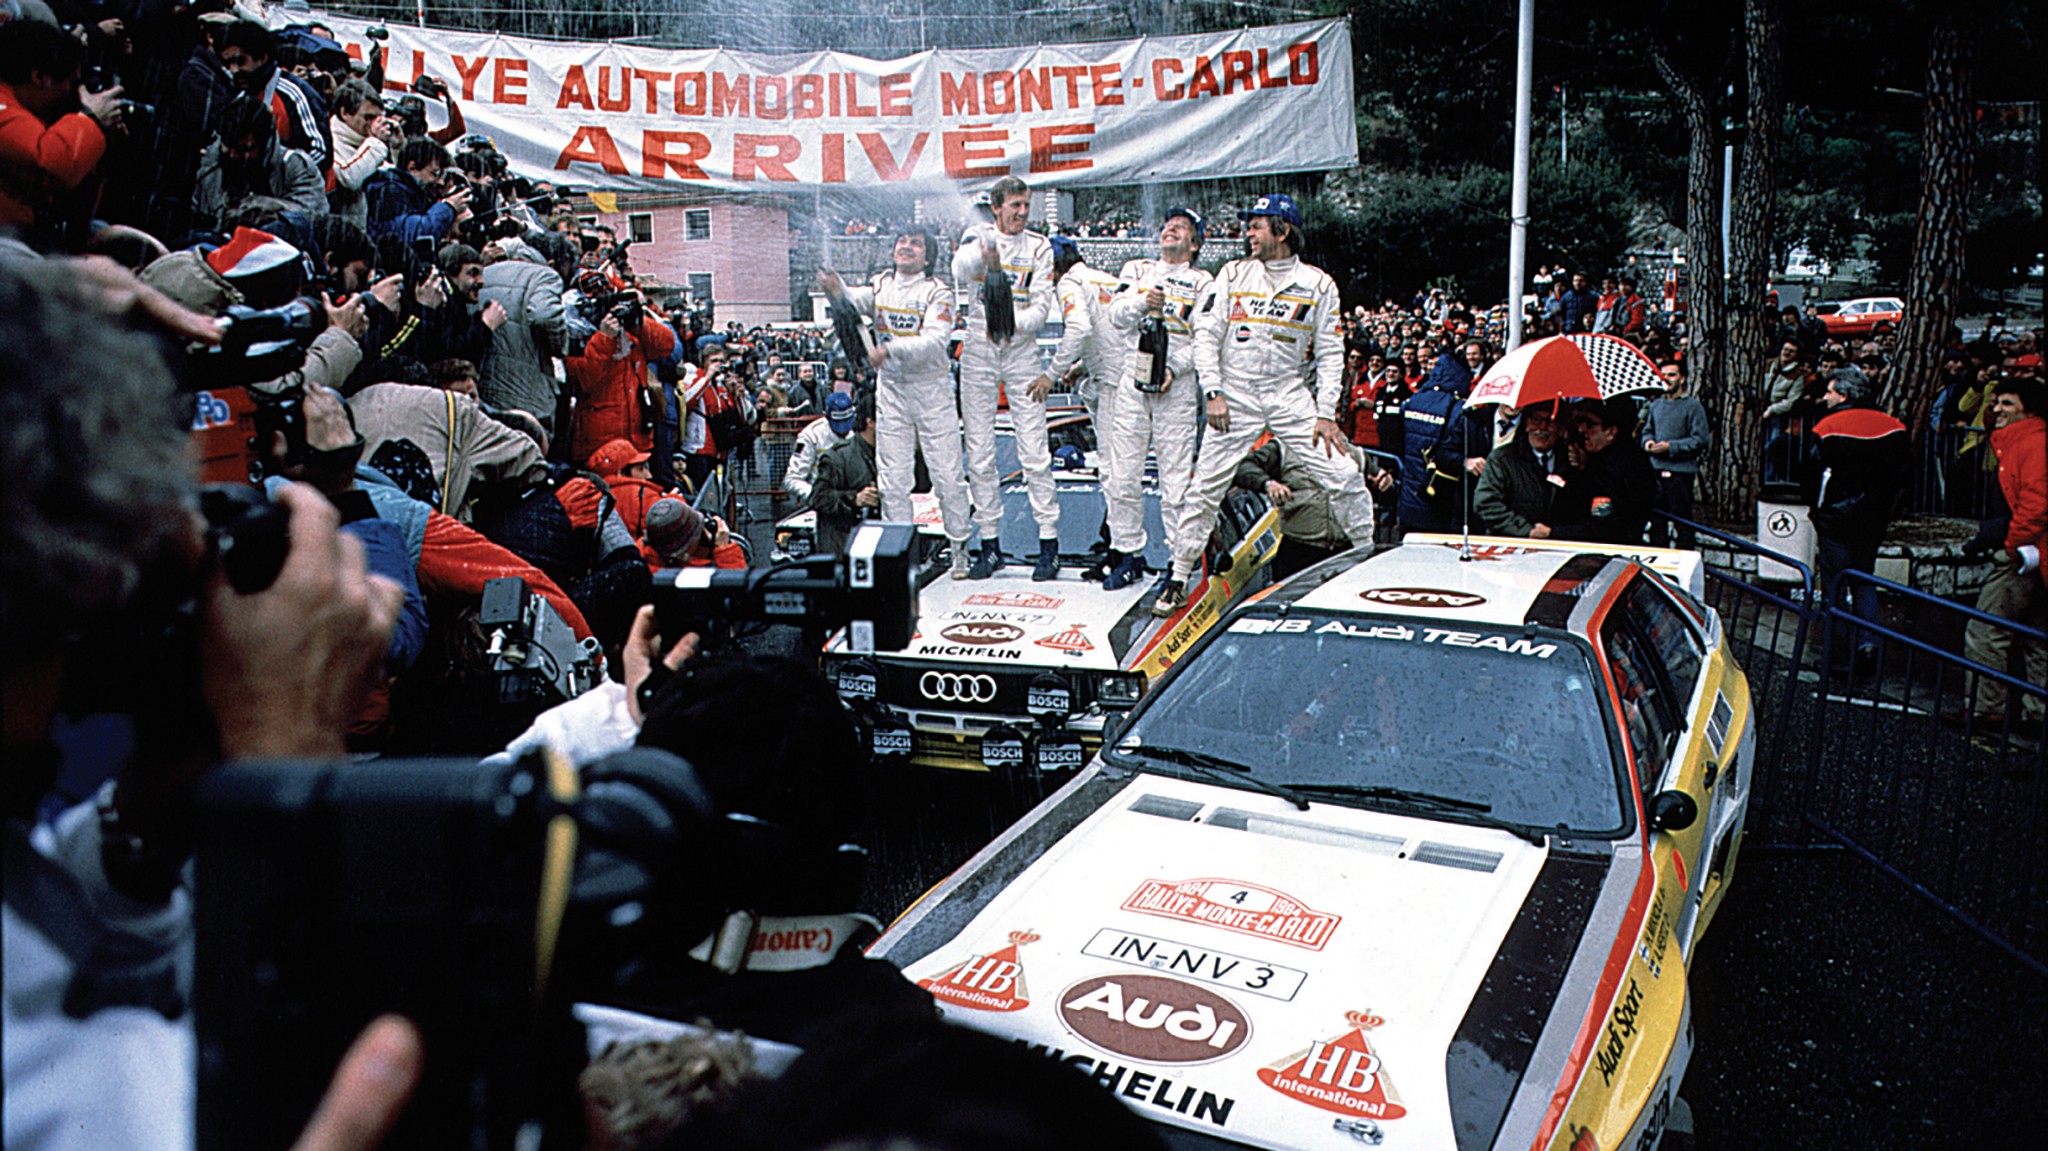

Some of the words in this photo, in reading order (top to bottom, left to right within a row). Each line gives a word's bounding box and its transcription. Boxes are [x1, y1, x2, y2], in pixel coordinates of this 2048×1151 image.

[556, 64, 913, 120] AUTOMOBILE
[940, 41, 1319, 116] MONTE-CARLO
[554, 123, 1095, 183] ARRIVÉE
[1367, 590, 1483, 606] Audi
[948, 625, 1021, 639] Audi
[1051, 632, 1085, 645] HB
[1314, 621, 1414, 641] Audi
[1423, 628, 1557, 658] TEAM
[919, 646, 1022, 660] MICHELIN
[838, 679, 876, 693] BOSCH
[1027, 694, 1070, 708] BOSCH
[873, 735, 911, 748] BOSCH
[982, 746, 1023, 758] BOSCH
[1039, 750, 1082, 762] BOSCH
[1133, 882, 1198, 914] RALLYE
[1193, 902, 1328, 944] MONTE-CARLO
[1230, 891, 1248, 904] 4
[1269, 897, 1300, 917] 1984
[753, 928, 832, 953] Canon
[951, 954, 1023, 993] HB
[1110, 936, 1240, 979] IN-NV
[1245, 966, 1275, 989] 3
[927, 982, 1013, 1011] international
[1065, 980, 1237, 1049] Audi
[1595, 1022, 1626, 1088] Audi
[1614, 977, 1644, 1038] Sport
[1299, 1040, 1382, 1094] HB
[1273, 1073, 1387, 1117] international
